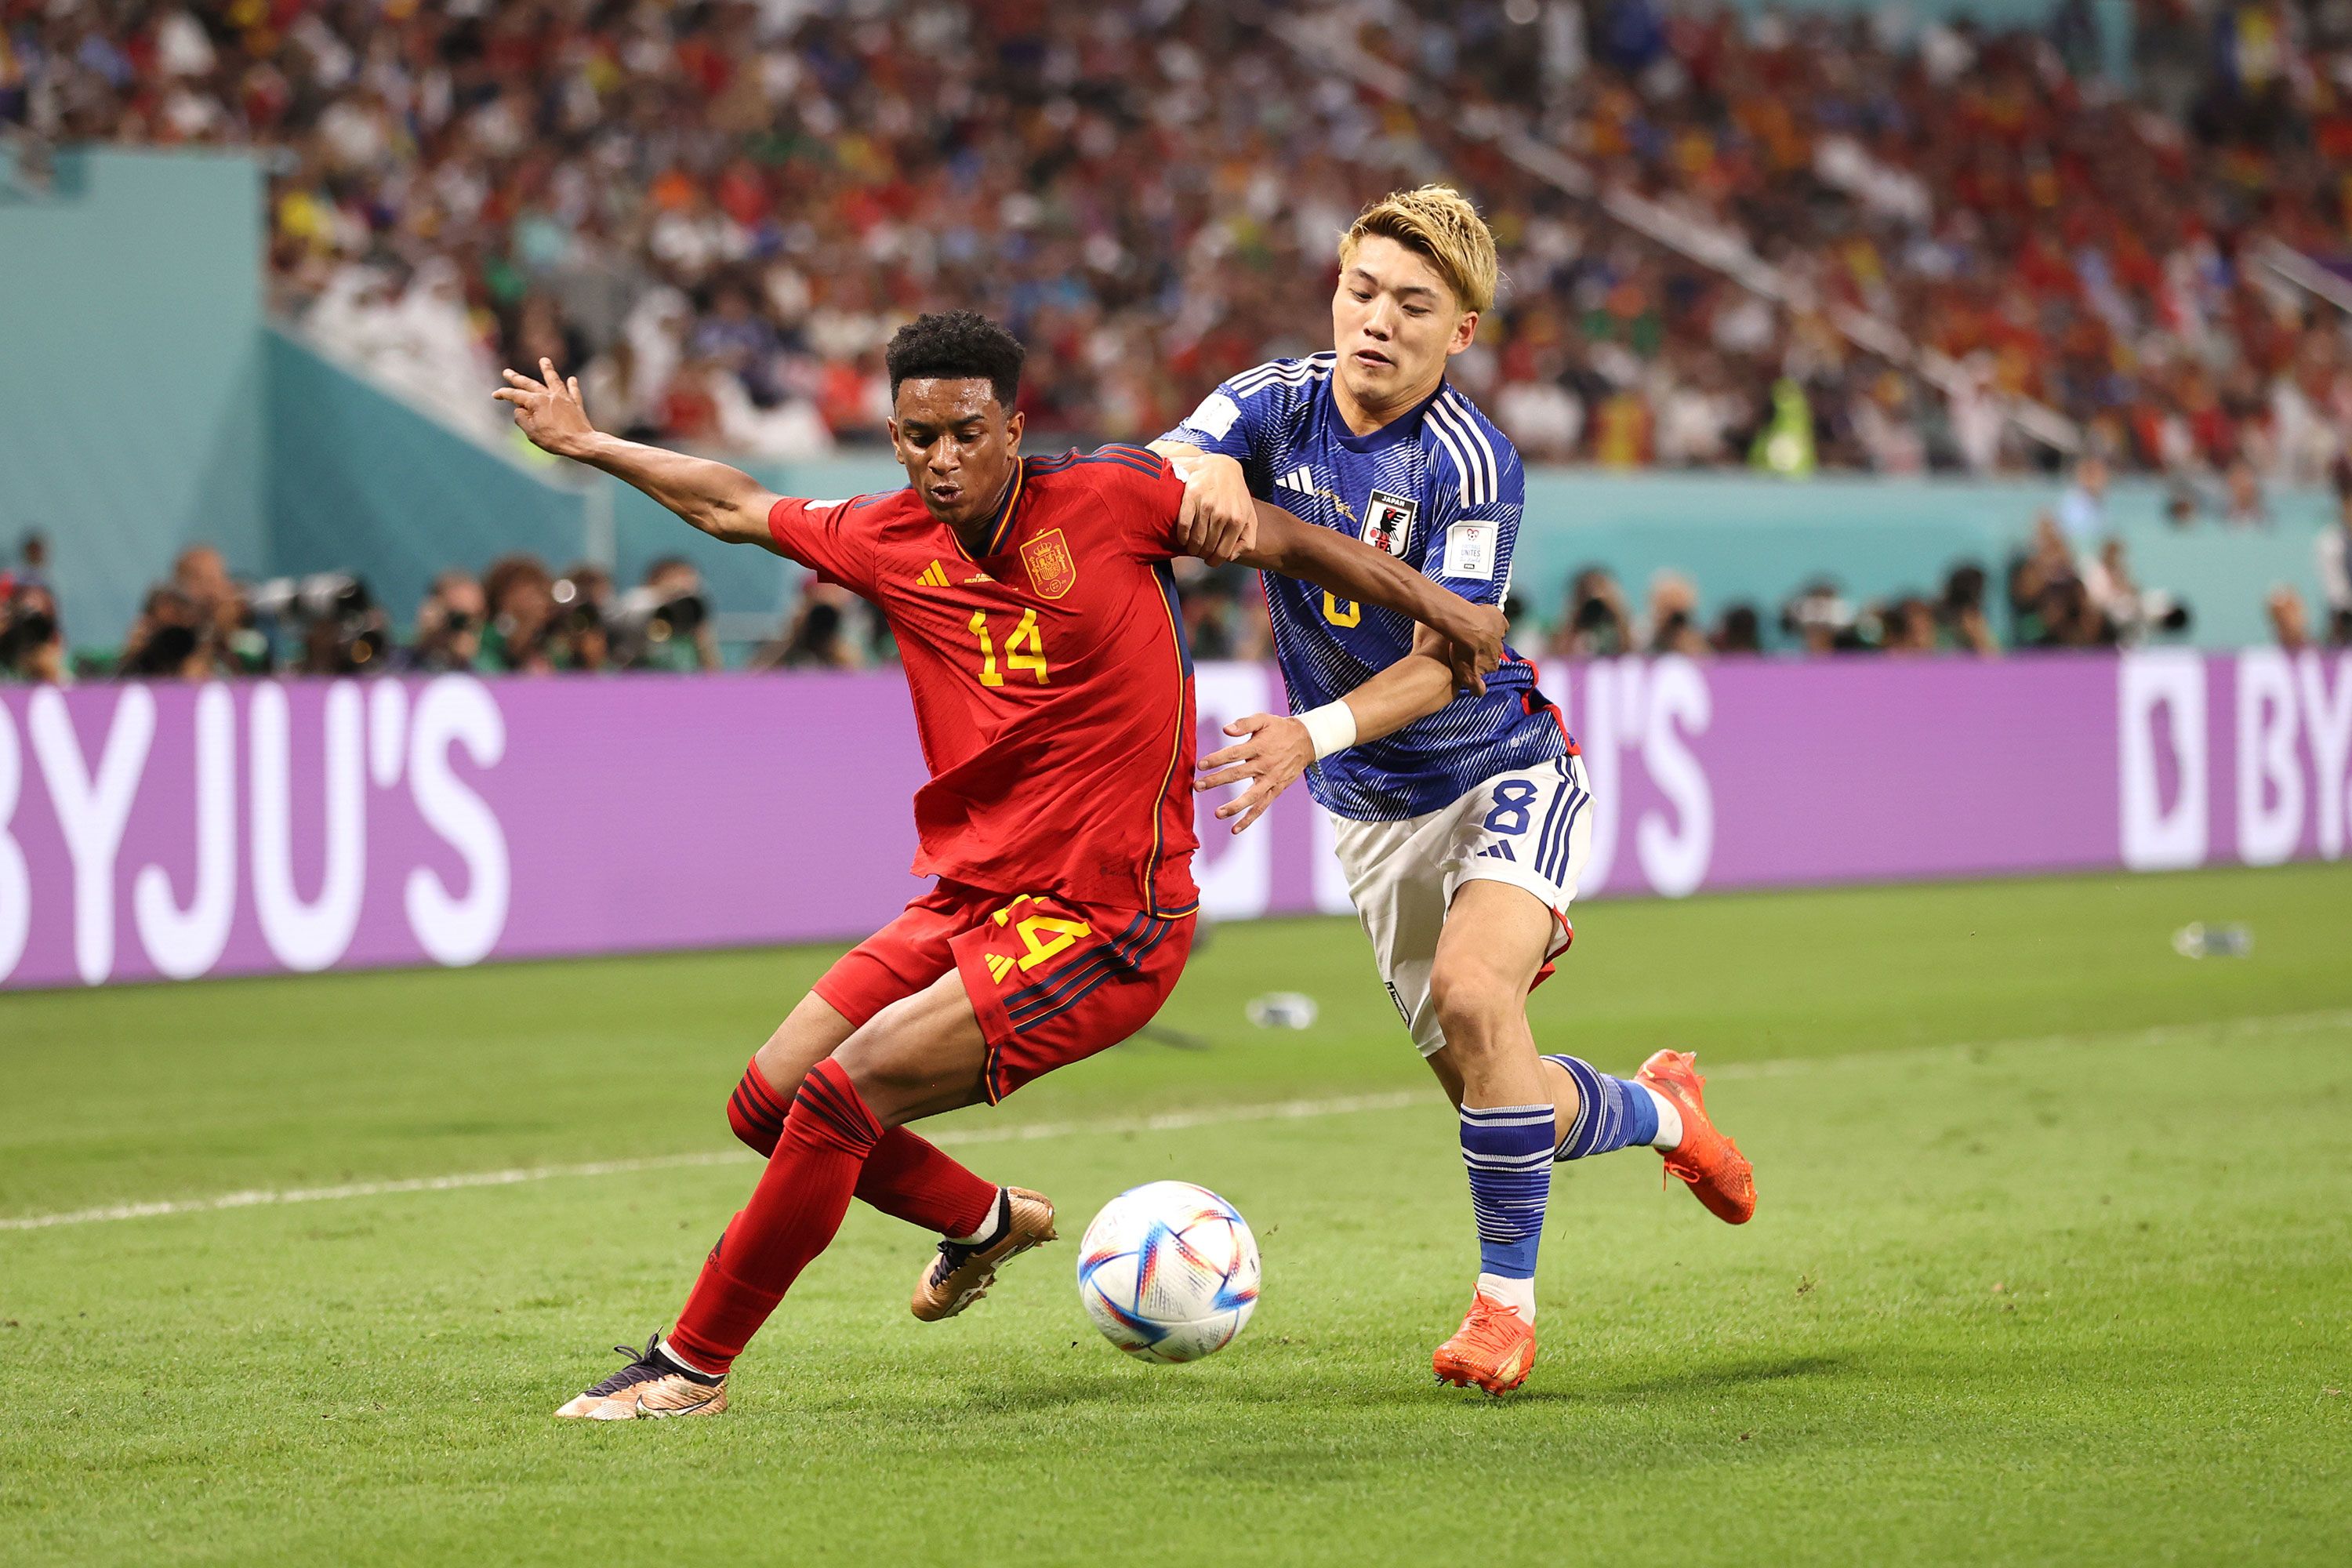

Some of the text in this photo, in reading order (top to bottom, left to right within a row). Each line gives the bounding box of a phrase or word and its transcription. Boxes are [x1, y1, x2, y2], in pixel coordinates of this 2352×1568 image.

[1381, 495, 1406, 507] JAPAN
[967, 608, 1051, 687] 14
[2237, 648, 2352, 866] BY
[1484, 779, 1537, 836] 8
